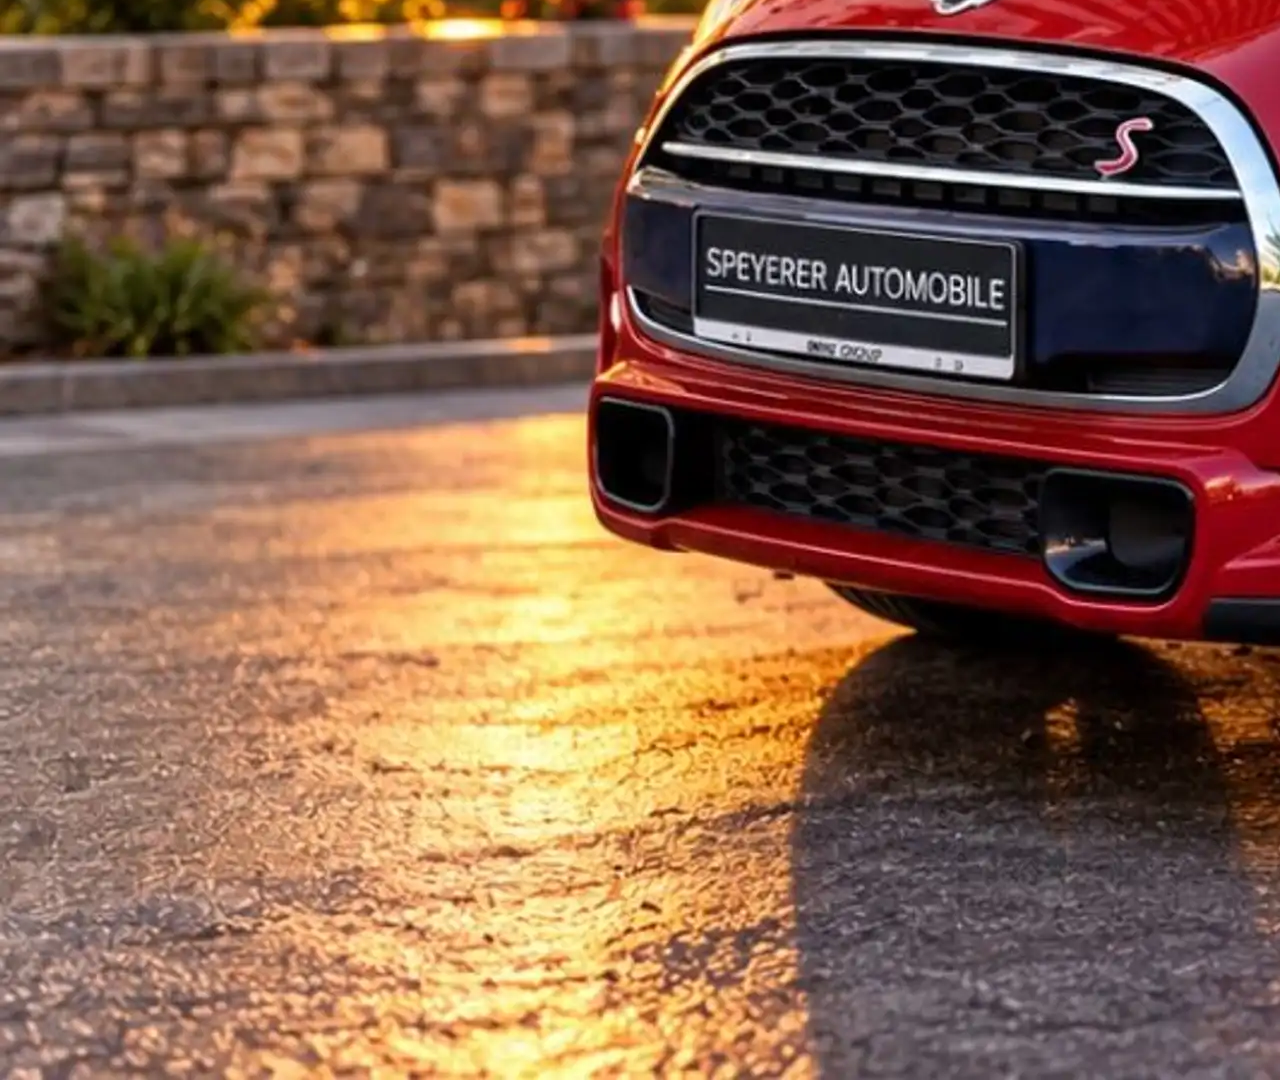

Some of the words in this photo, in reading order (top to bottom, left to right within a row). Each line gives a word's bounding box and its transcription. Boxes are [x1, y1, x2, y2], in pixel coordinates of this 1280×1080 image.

[1094, 116, 1154, 177] S
[706, 247, 828, 291] SPEYERER
[834, 263, 1006, 310] AUTOMOBILE
